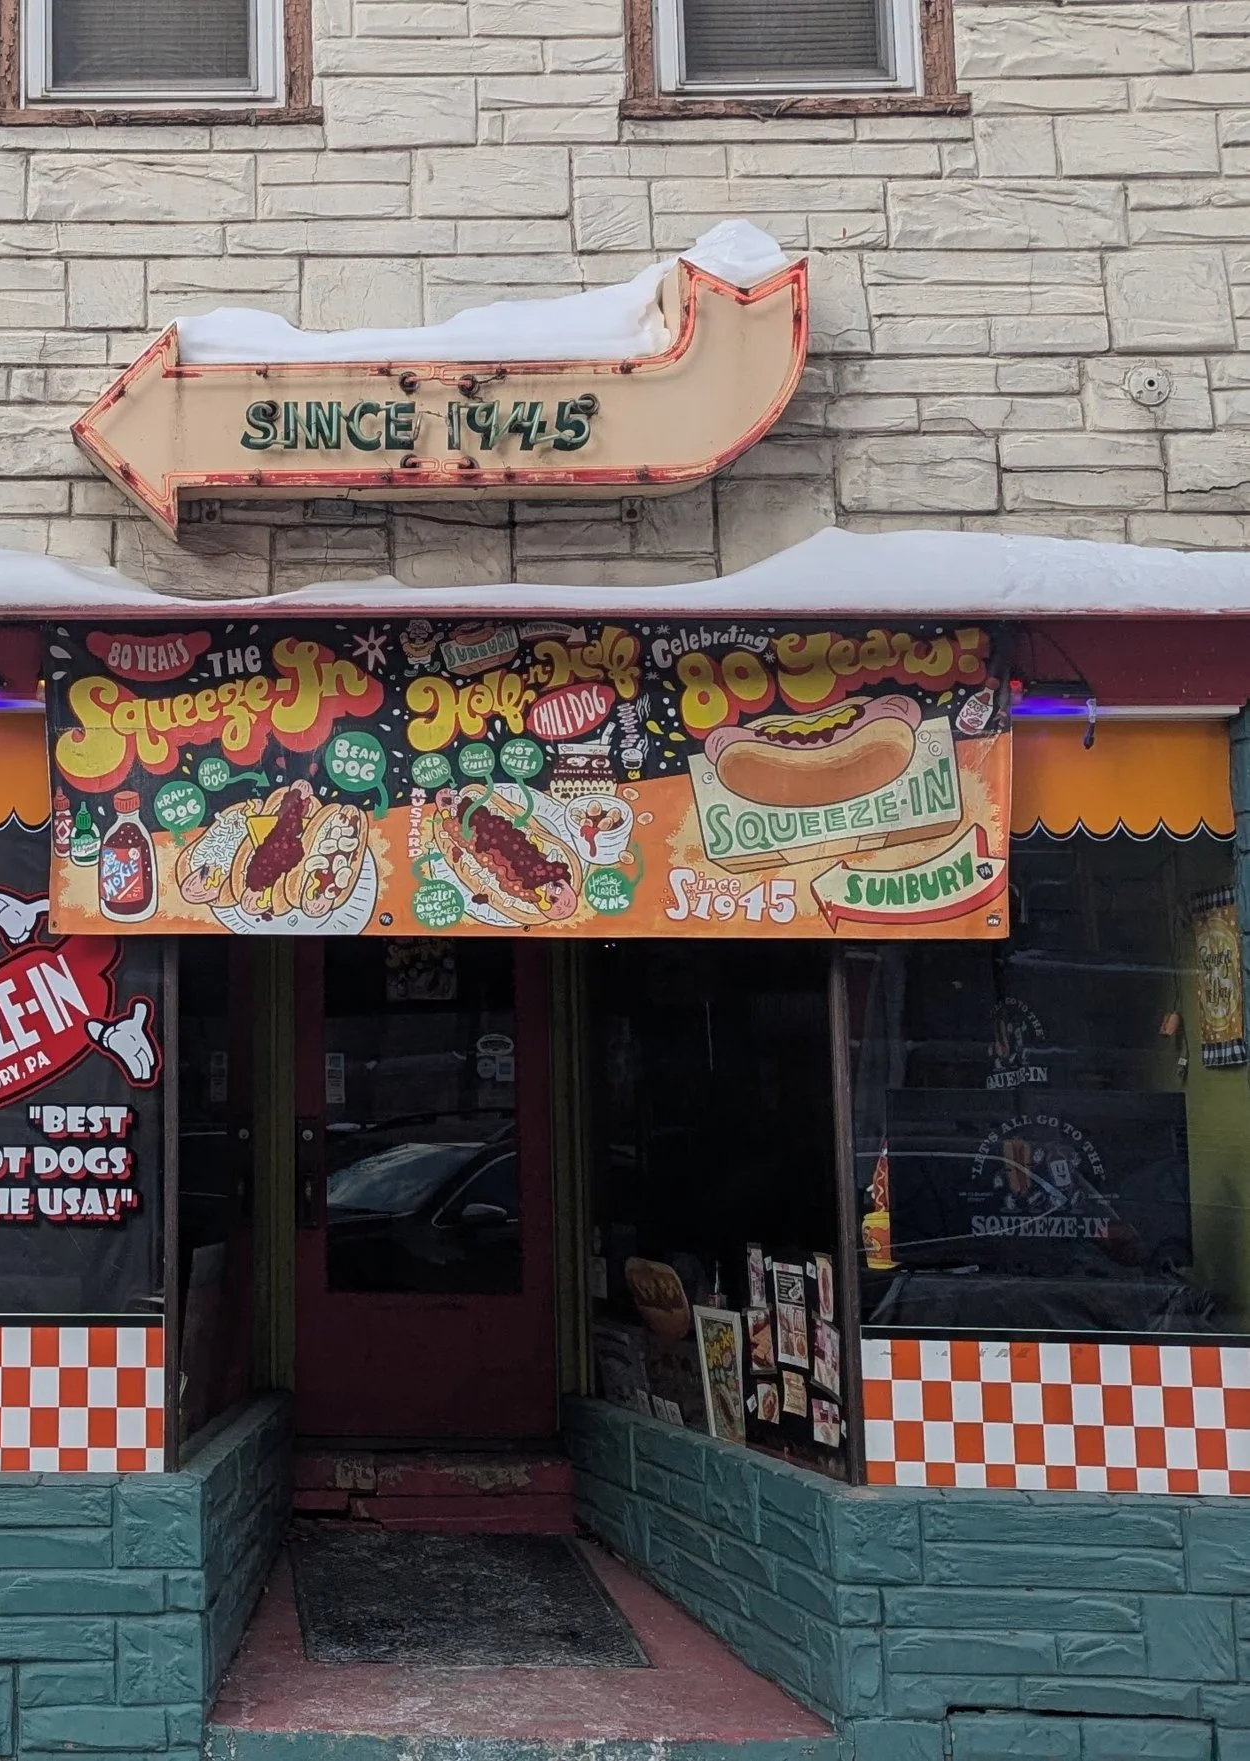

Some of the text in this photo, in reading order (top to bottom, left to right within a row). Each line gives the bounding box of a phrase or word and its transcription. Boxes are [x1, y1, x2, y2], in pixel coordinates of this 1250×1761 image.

[240, 397, 600, 451] SINCE 1945
[107, 638, 190, 673] 80 YEARS
[651, 624, 769, 668] Celebrating
[676, 650, 771, 730] 80
[55, 637, 370, 779] Squeeze-In
[334, 739, 381, 762] BEAN
[502, 755, 537, 771] CHILI
[504, 745, 535, 756] HOT
[202, 768, 228, 787] DOG
[331, 760, 376, 781] DOG
[412, 757, 441, 776] DICED
[416, 764, 449, 784] ONIONS
[156, 787, 194, 810] KRAUT
[161, 802, 201, 822] DOG
[407, 787, 428, 858] MUSTARD
[102, 859, 140, 902] MOXIE
[843, 851, 974, 906] SUNBURY
[979, 866, 992, 878] PA
[416, 901, 442, 913] DOG
[588, 893, 630, 910] BEANS
[665, 867, 741, 922] Since
[691, 878, 797, 924] 1945
[27, 1052, 51, 1076] PA
[28, 1104, 132, 1134] "BEST
[1000, 1114, 1033, 1135] ALL
[1036, 1114, 1059, 1128] GO
[1062, 1121, 1084, 1142] TO
[33, 1146, 128, 1175] DOGS
[37, 1187, 134, 1216] USA!"
[969, 1214, 1111, 1239] SQUEEZE-IN
